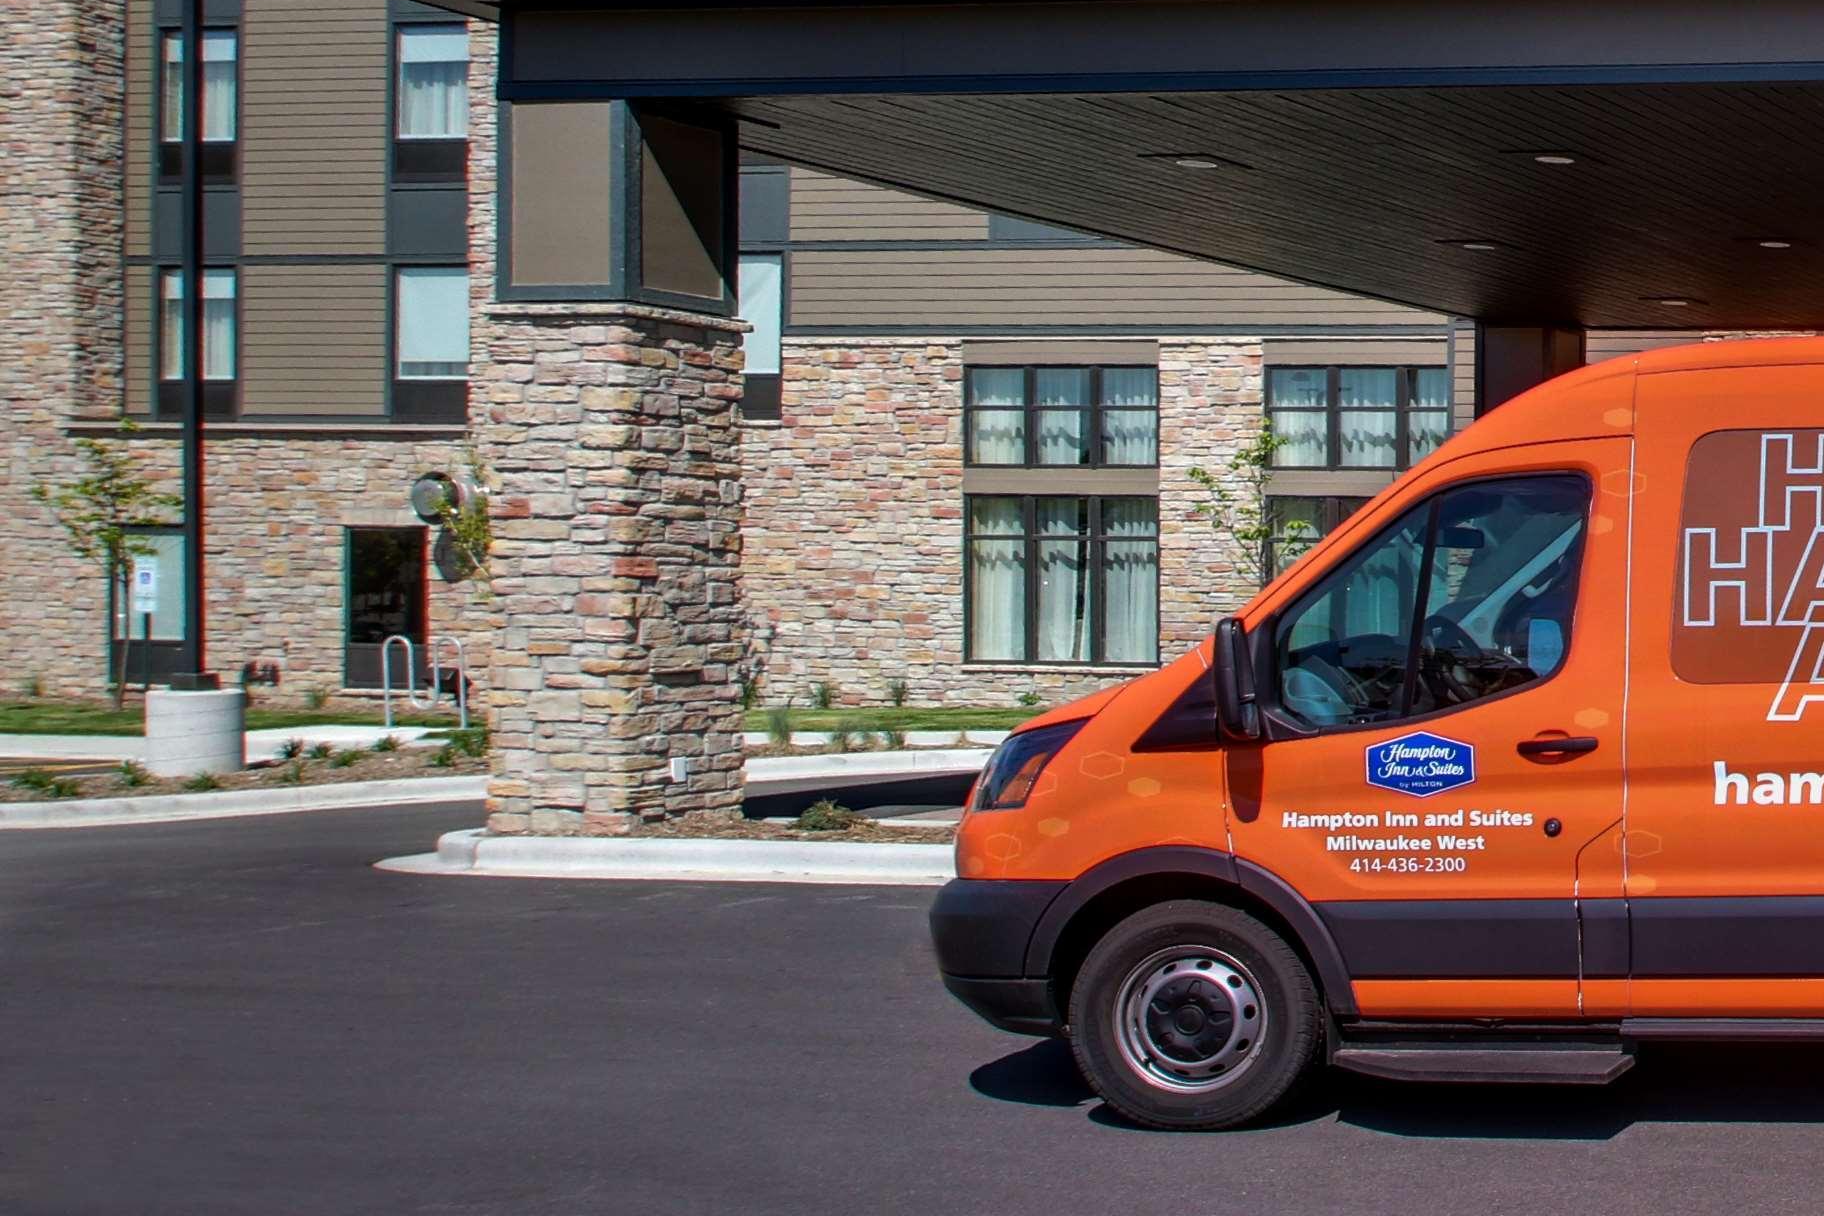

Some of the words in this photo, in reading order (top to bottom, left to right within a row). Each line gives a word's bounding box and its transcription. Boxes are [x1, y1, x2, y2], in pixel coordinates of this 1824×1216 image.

[1380, 743, 1456, 763] Hampton
[1377, 762, 1415, 779] Inn
[1415, 766, 1425, 777] &
[1423, 761, 1465, 776] Suites
[1282, 811, 1379, 831] Hampton
[1385, 810, 1419, 827] Inn
[1423, 809, 1464, 827] and
[1469, 809, 1534, 827] Suites
[1326, 834, 1432, 851] Milwaukee
[1436, 835, 1485, 850] West
[1349, 857, 1466, 873] 414-436-2300
